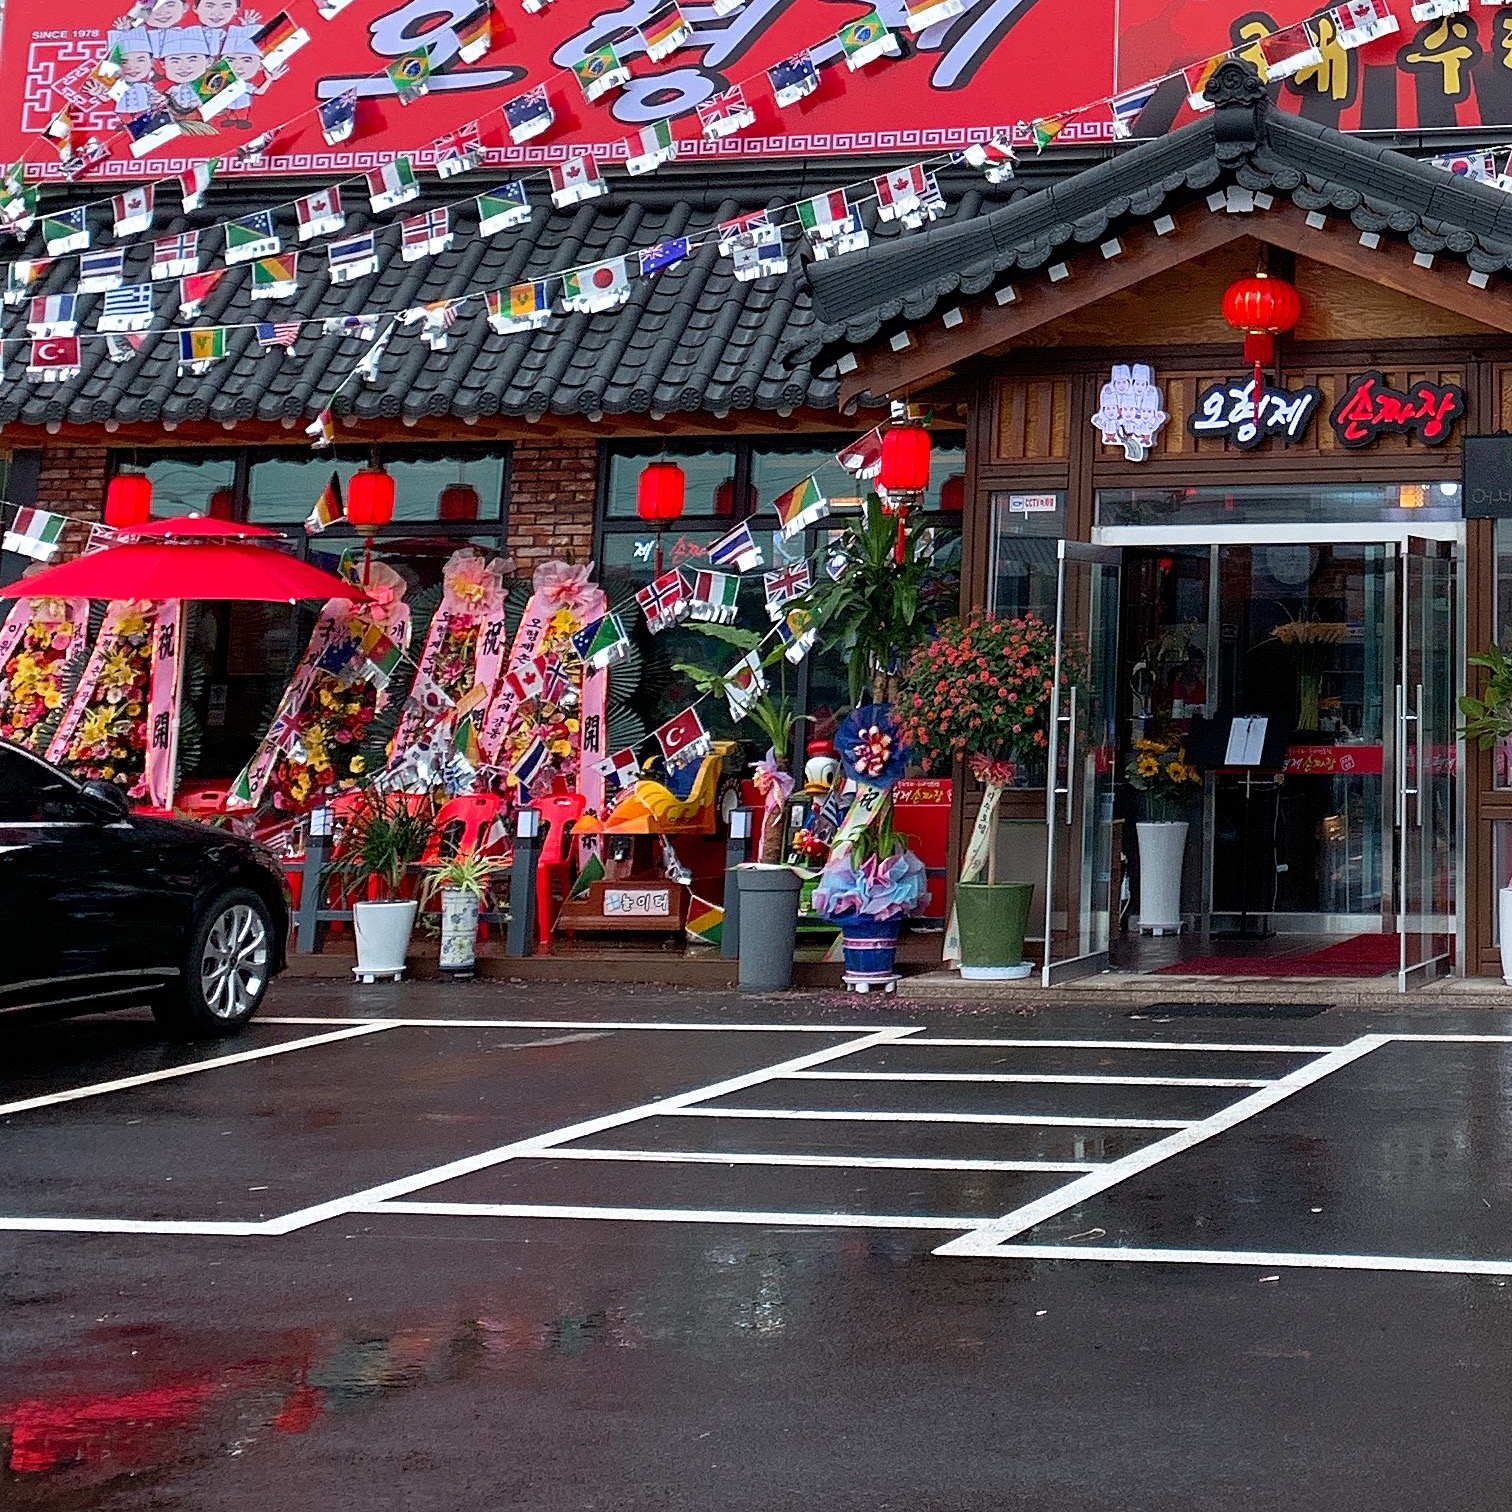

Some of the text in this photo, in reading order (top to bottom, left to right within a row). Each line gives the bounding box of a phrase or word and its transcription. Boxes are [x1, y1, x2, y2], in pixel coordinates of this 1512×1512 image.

[32, 29, 100, 39] SINCE 1978
[1194, 379, 1455, 442] 오형제 손짜장
